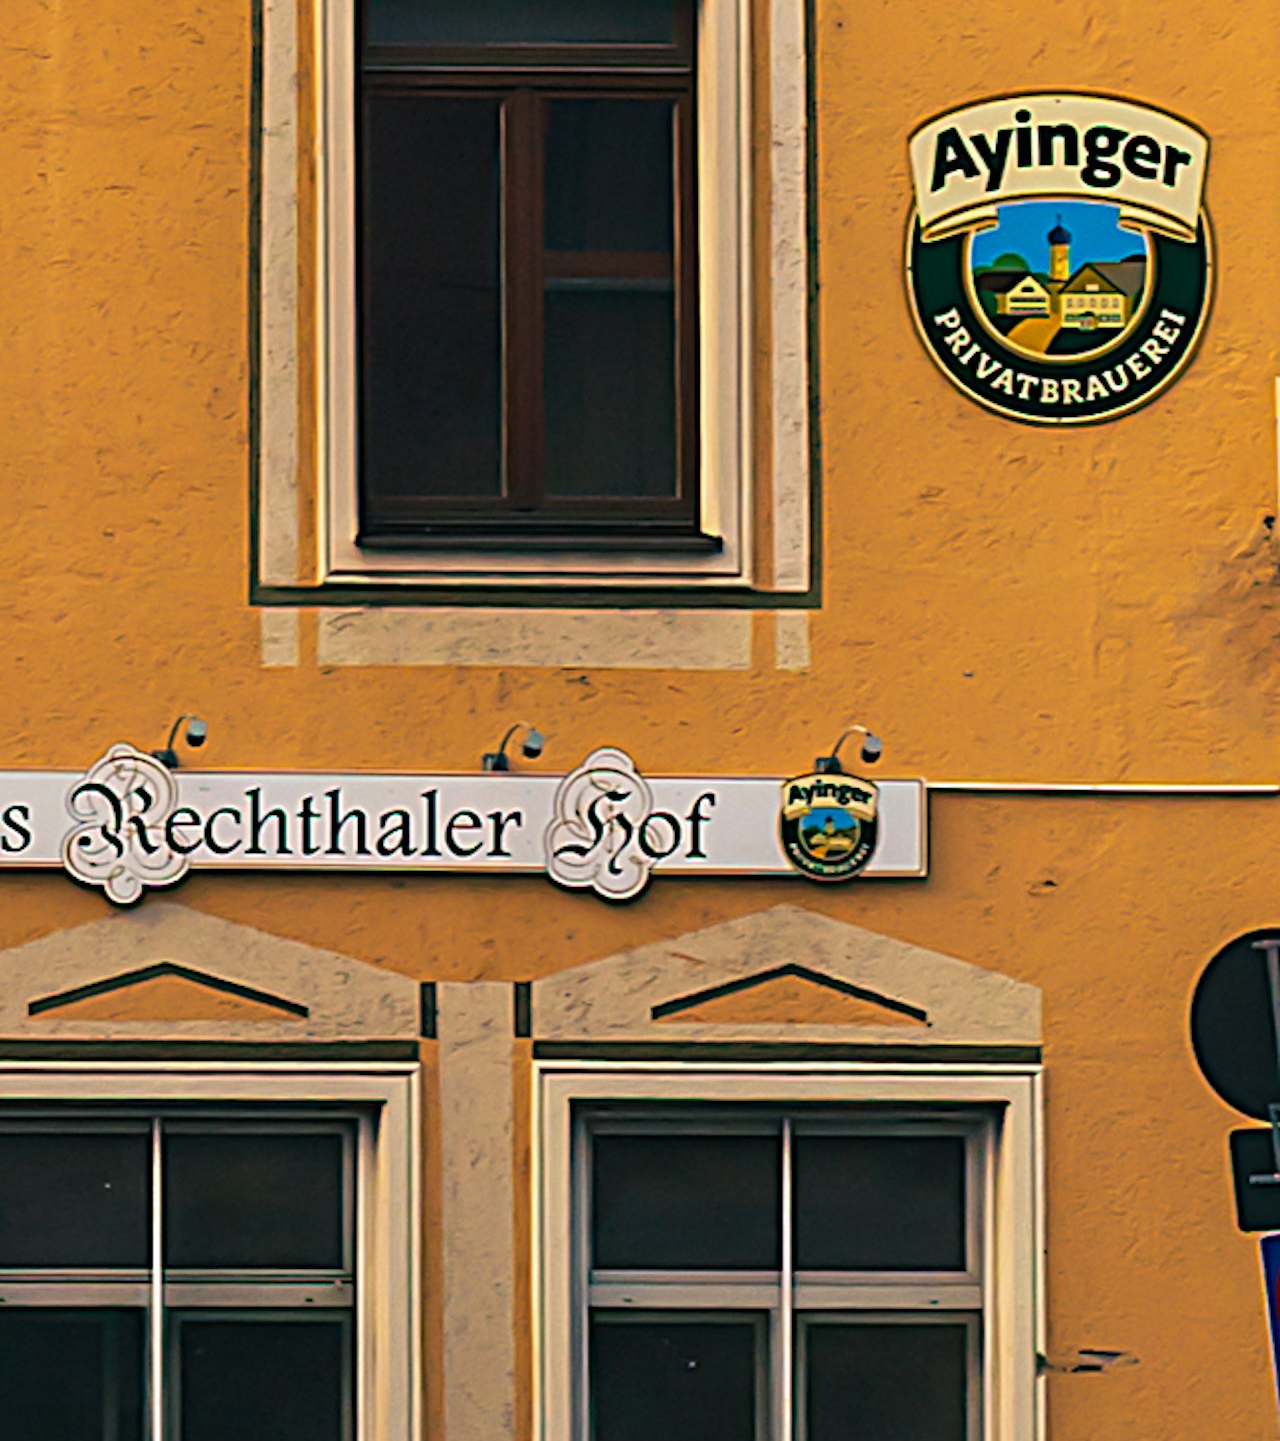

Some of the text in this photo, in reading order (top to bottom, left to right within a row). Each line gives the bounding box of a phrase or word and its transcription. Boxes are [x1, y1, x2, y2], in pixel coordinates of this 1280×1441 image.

[929, 108, 1193, 193] Ayinger
[933, 307, 1188, 405] PRIVATBRAUEREI
[70, 781, 523, 860] Rechthaler
[552, 790, 716, 874] Hof
[787, 778, 873, 806] Ayinger
